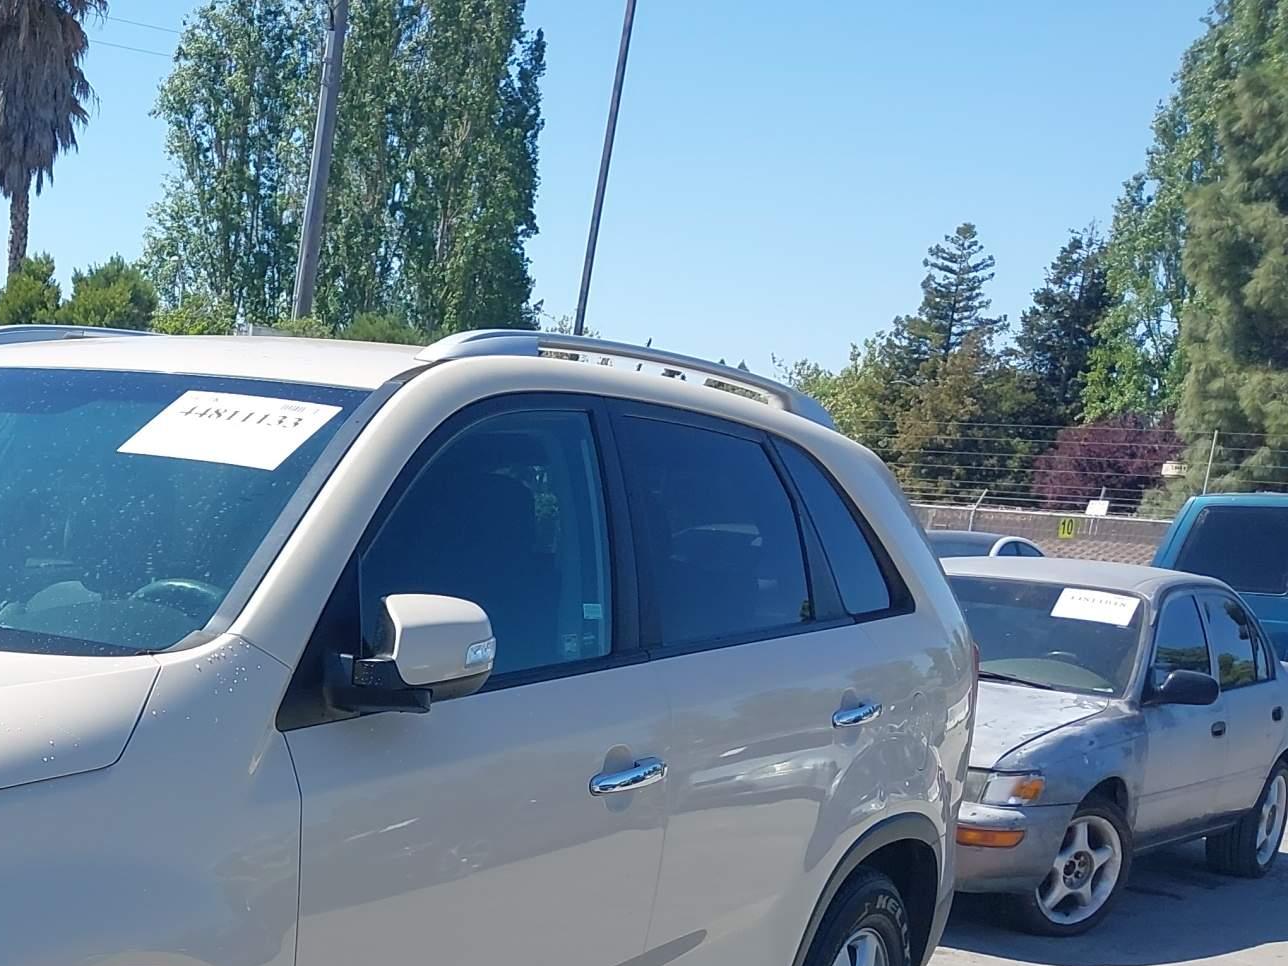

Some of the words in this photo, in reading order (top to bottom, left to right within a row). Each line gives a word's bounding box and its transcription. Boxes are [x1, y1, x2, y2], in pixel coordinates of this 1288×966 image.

[176, 405, 304, 430] 44811133
[1061, 518, 1074, 536] 10
[875, 894, 911, 960] KELLY
